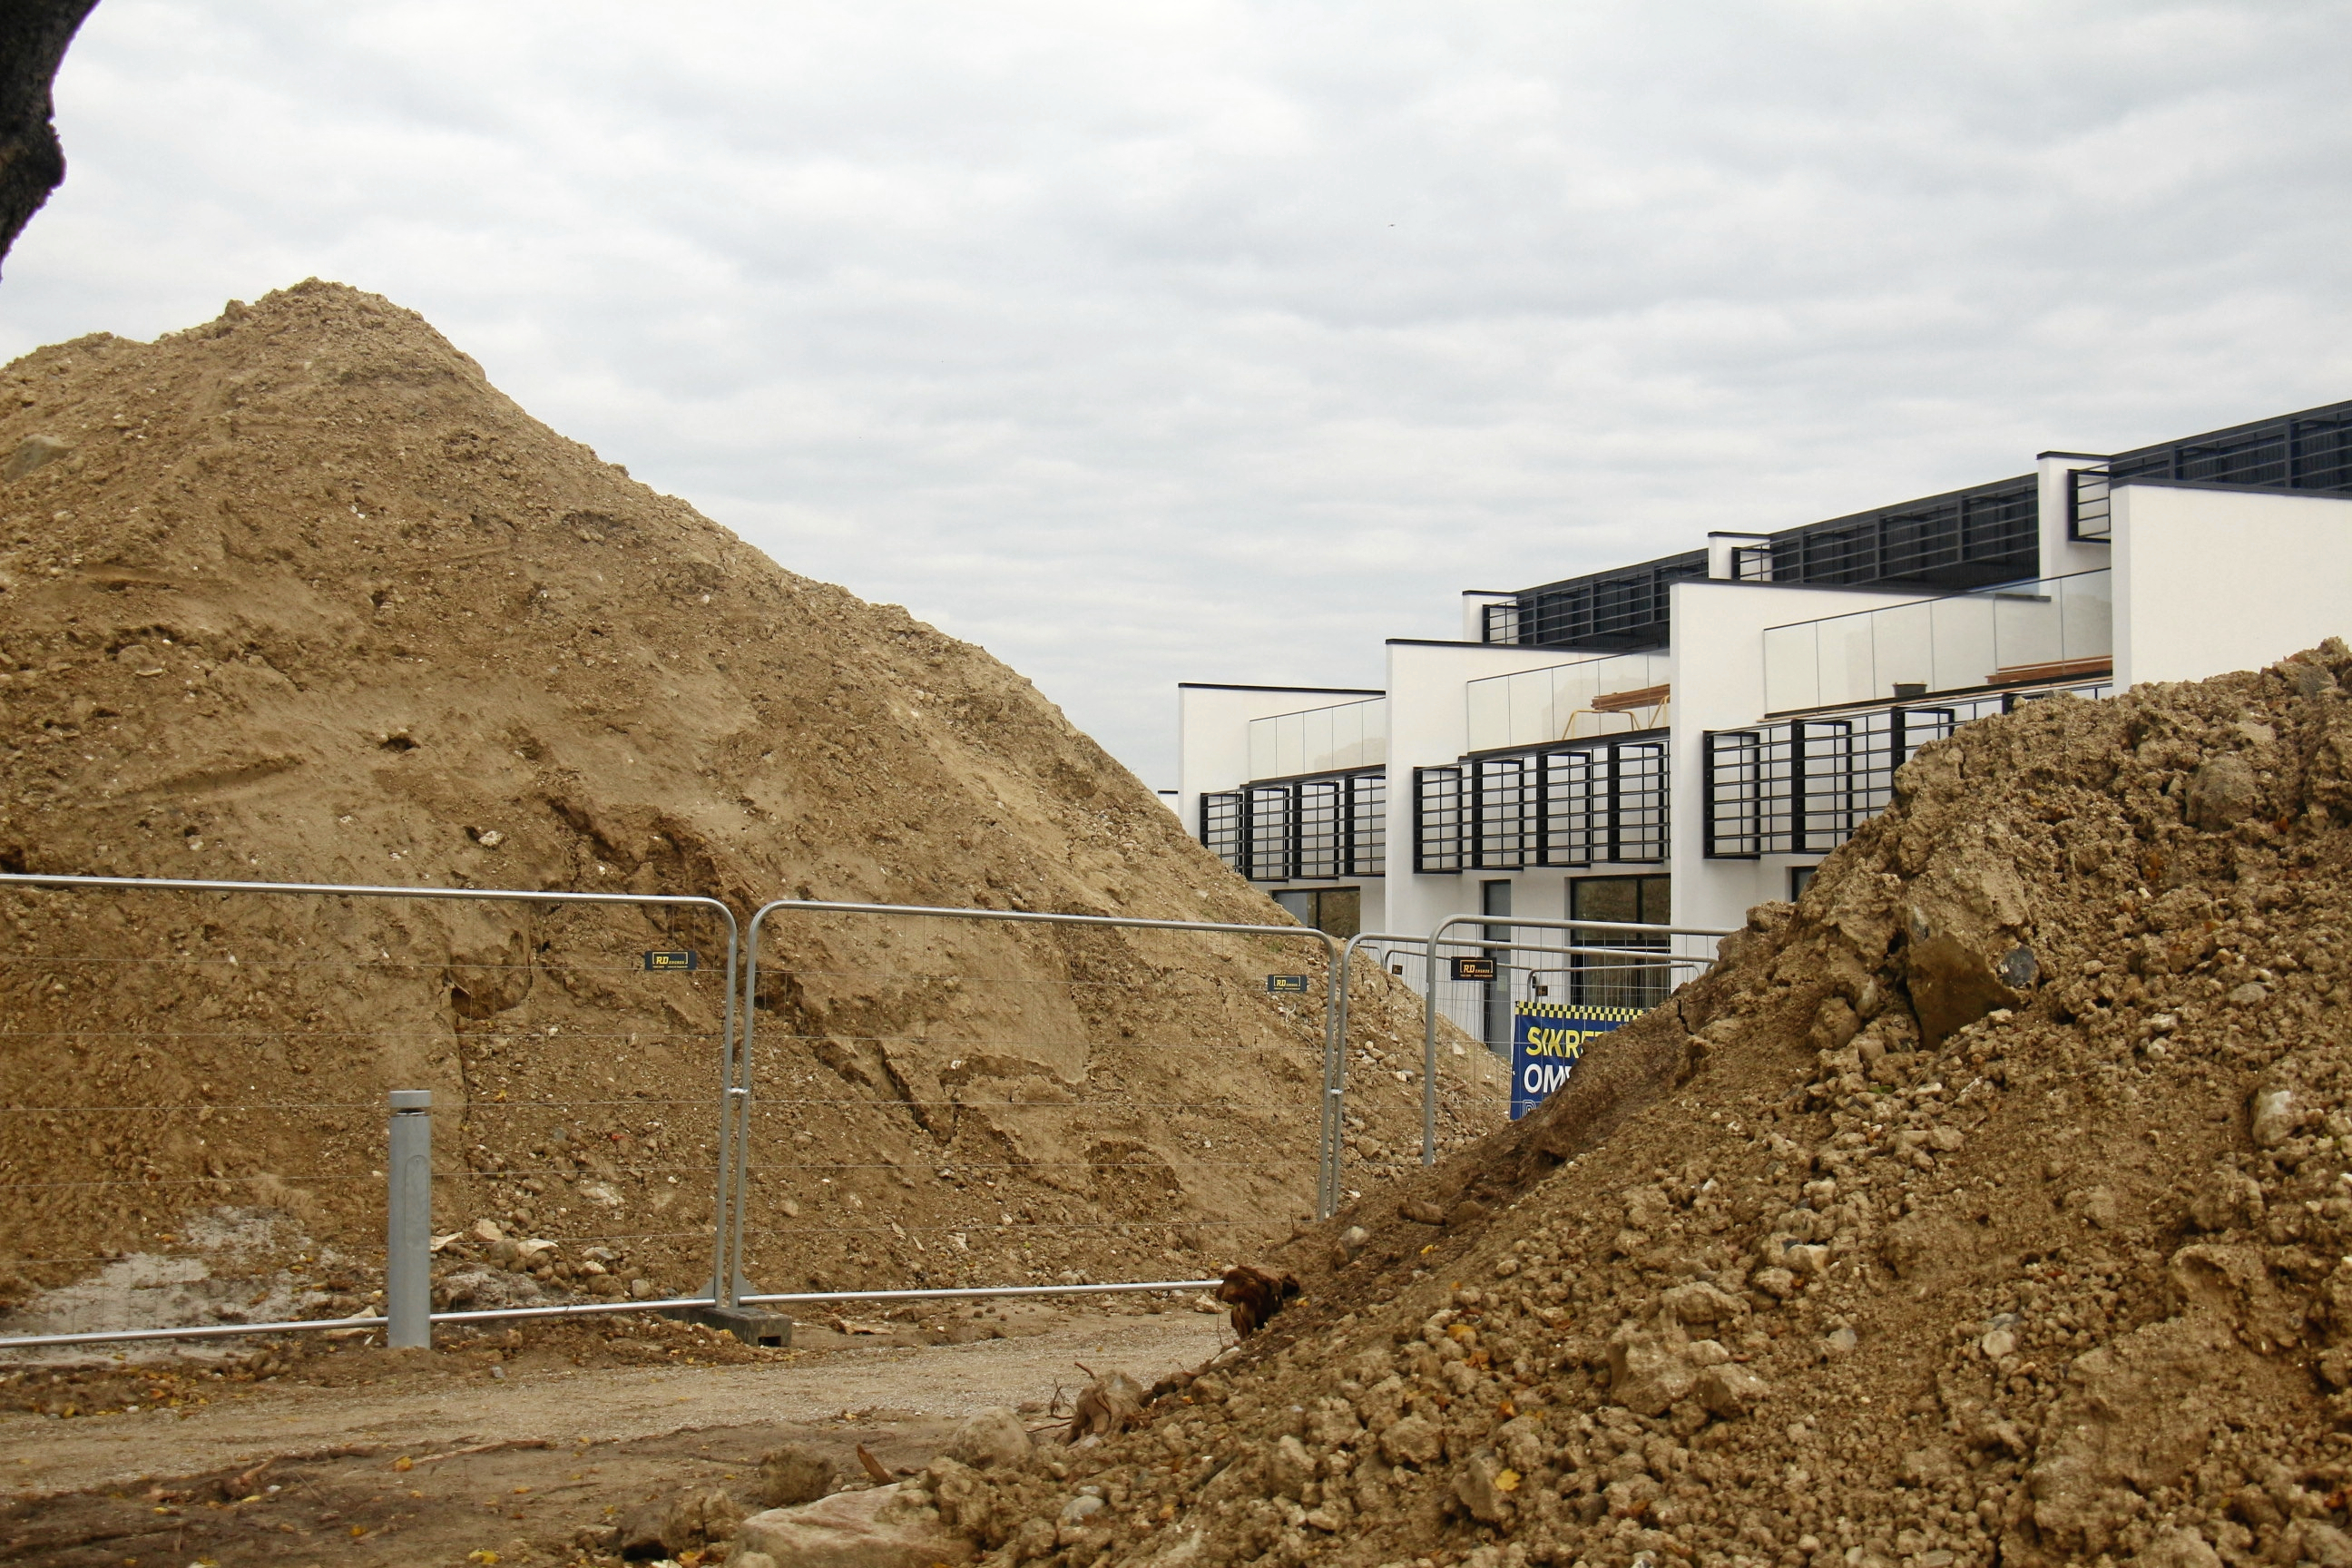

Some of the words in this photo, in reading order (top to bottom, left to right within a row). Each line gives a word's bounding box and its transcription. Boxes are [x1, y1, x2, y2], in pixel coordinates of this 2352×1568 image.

[656, 956, 670, 965] RD
[1463, 964, 1475, 974] RD
[1276, 979, 1287, 987] RD
[1525, 1026, 1603, 1059] SIKR
[1524, 1063, 1573, 1093] OM
